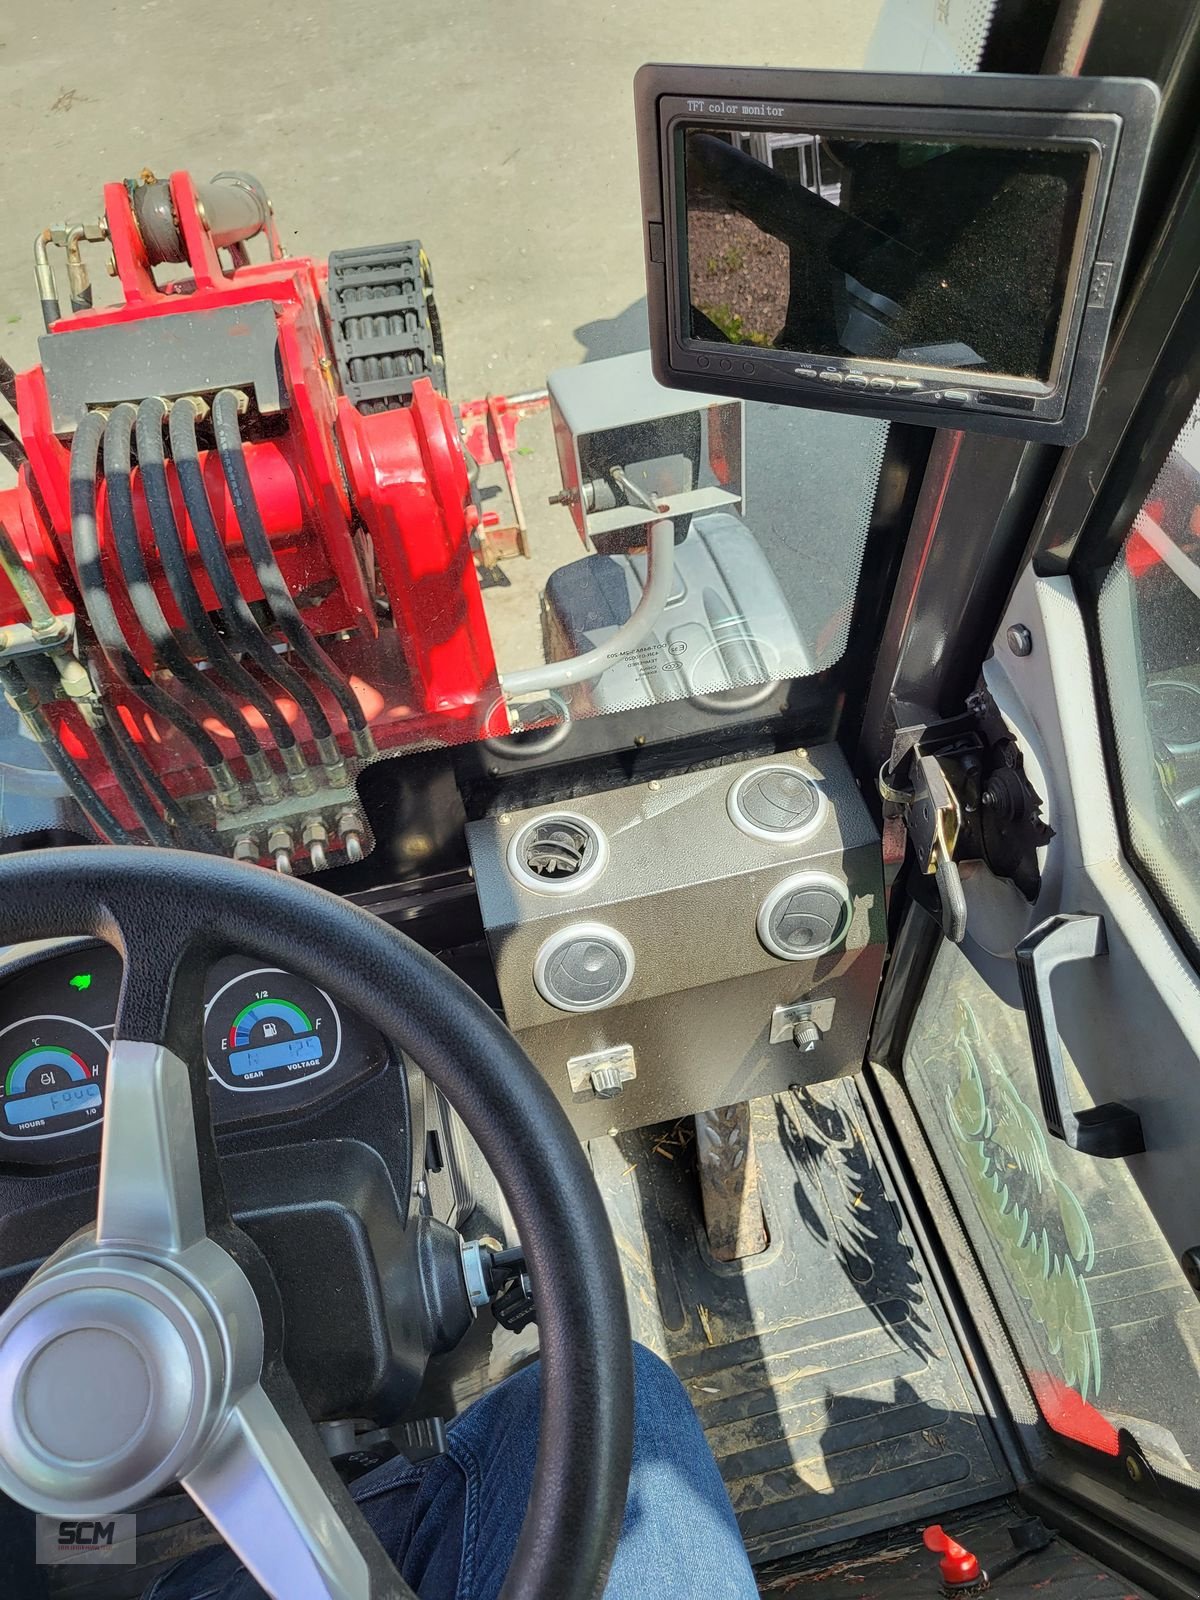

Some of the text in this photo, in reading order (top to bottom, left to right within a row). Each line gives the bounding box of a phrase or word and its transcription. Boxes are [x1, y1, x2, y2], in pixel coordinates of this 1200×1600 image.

[687, 100, 784, 116] TFT color monitor
[255, 990, 269, 1000] 1/2
[315, 1018, 322, 1030] F
[221, 1038, 228, 1050] E
[92, 1064, 99, 1077] H
[287, 1059, 321, 1071] VOLTAGE
[243, 1071, 264, 1080] GEAR
[18, 1120, 46, 1130] HOURS
